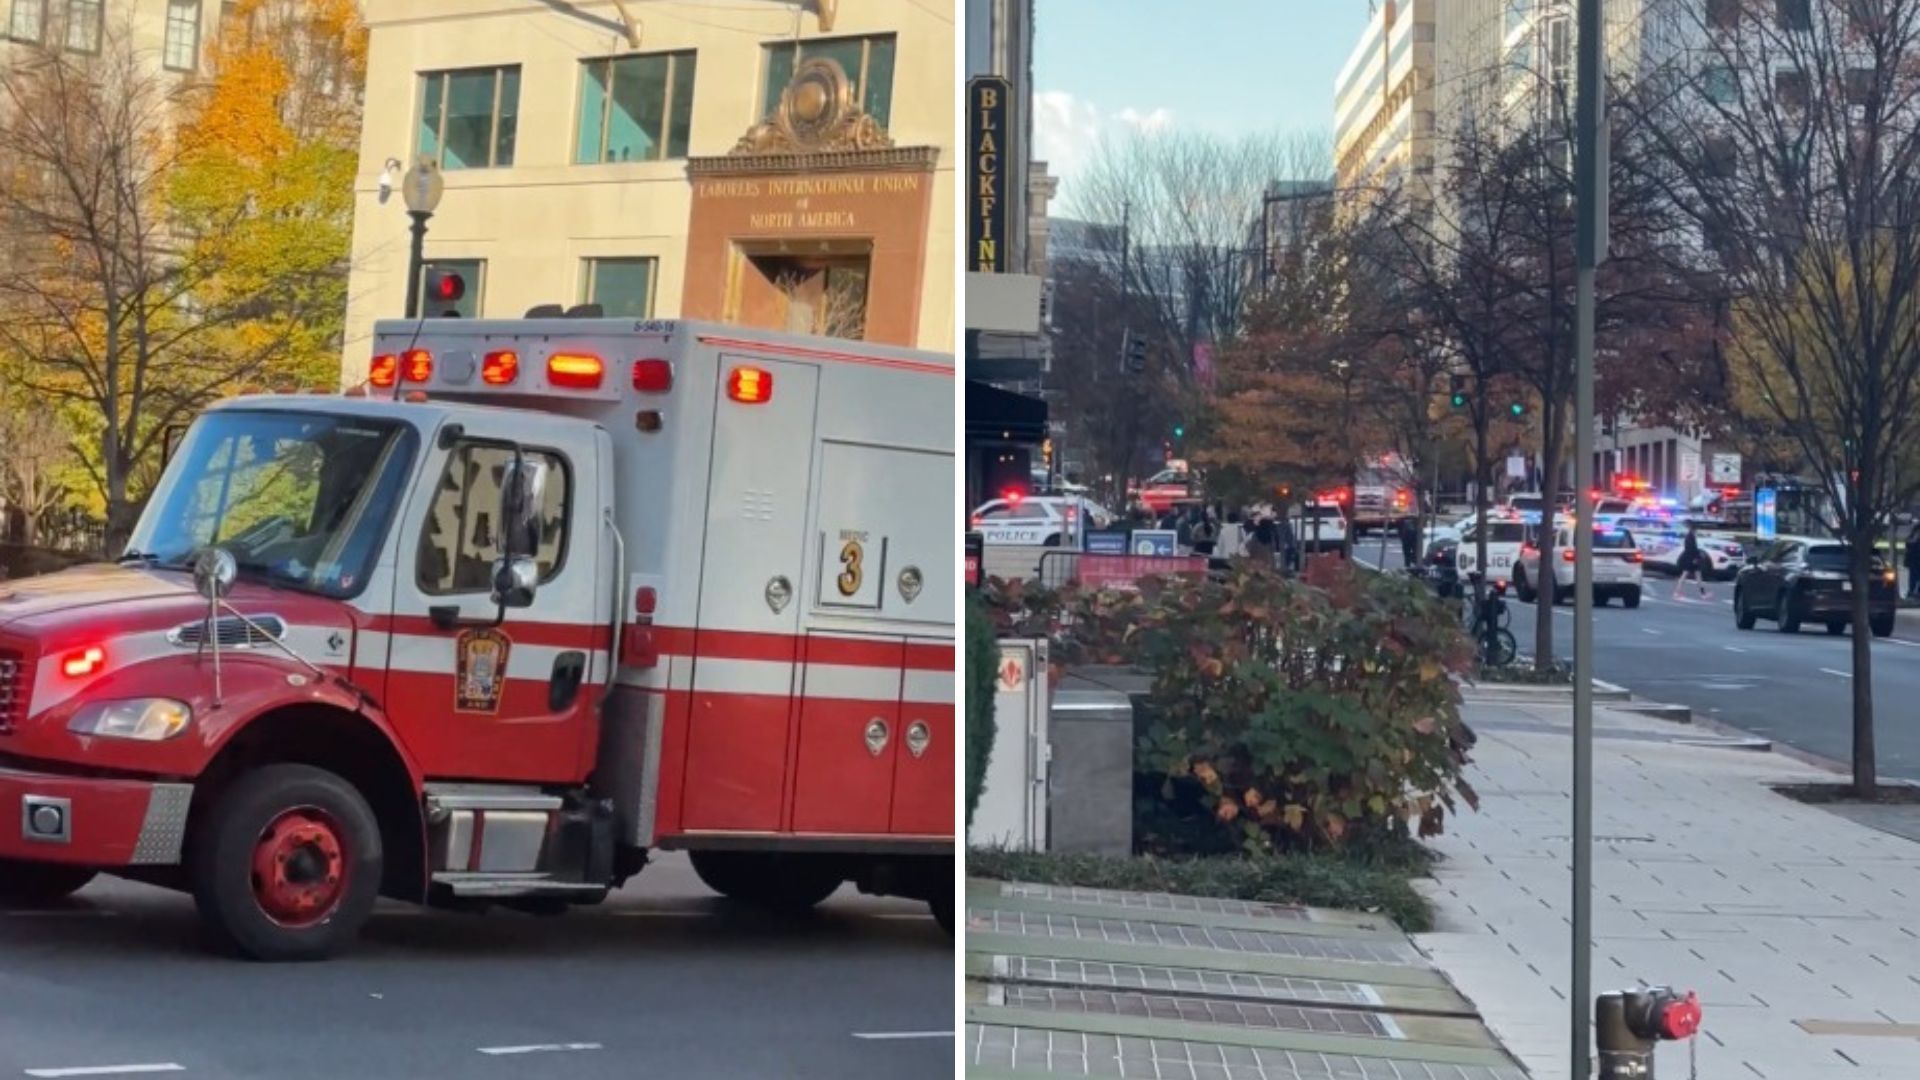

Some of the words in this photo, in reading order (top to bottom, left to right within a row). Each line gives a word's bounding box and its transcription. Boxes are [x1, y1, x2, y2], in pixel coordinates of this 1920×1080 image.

[768, 177, 864, 195] INTERNATIONAL
[873, 174, 918, 192] UNION
[750, 213, 792, 228] NORTH
[799, 212, 854, 227] AMERICA
[986, 531, 1039, 540] POLICE
[837, 541, 863, 597] 3
